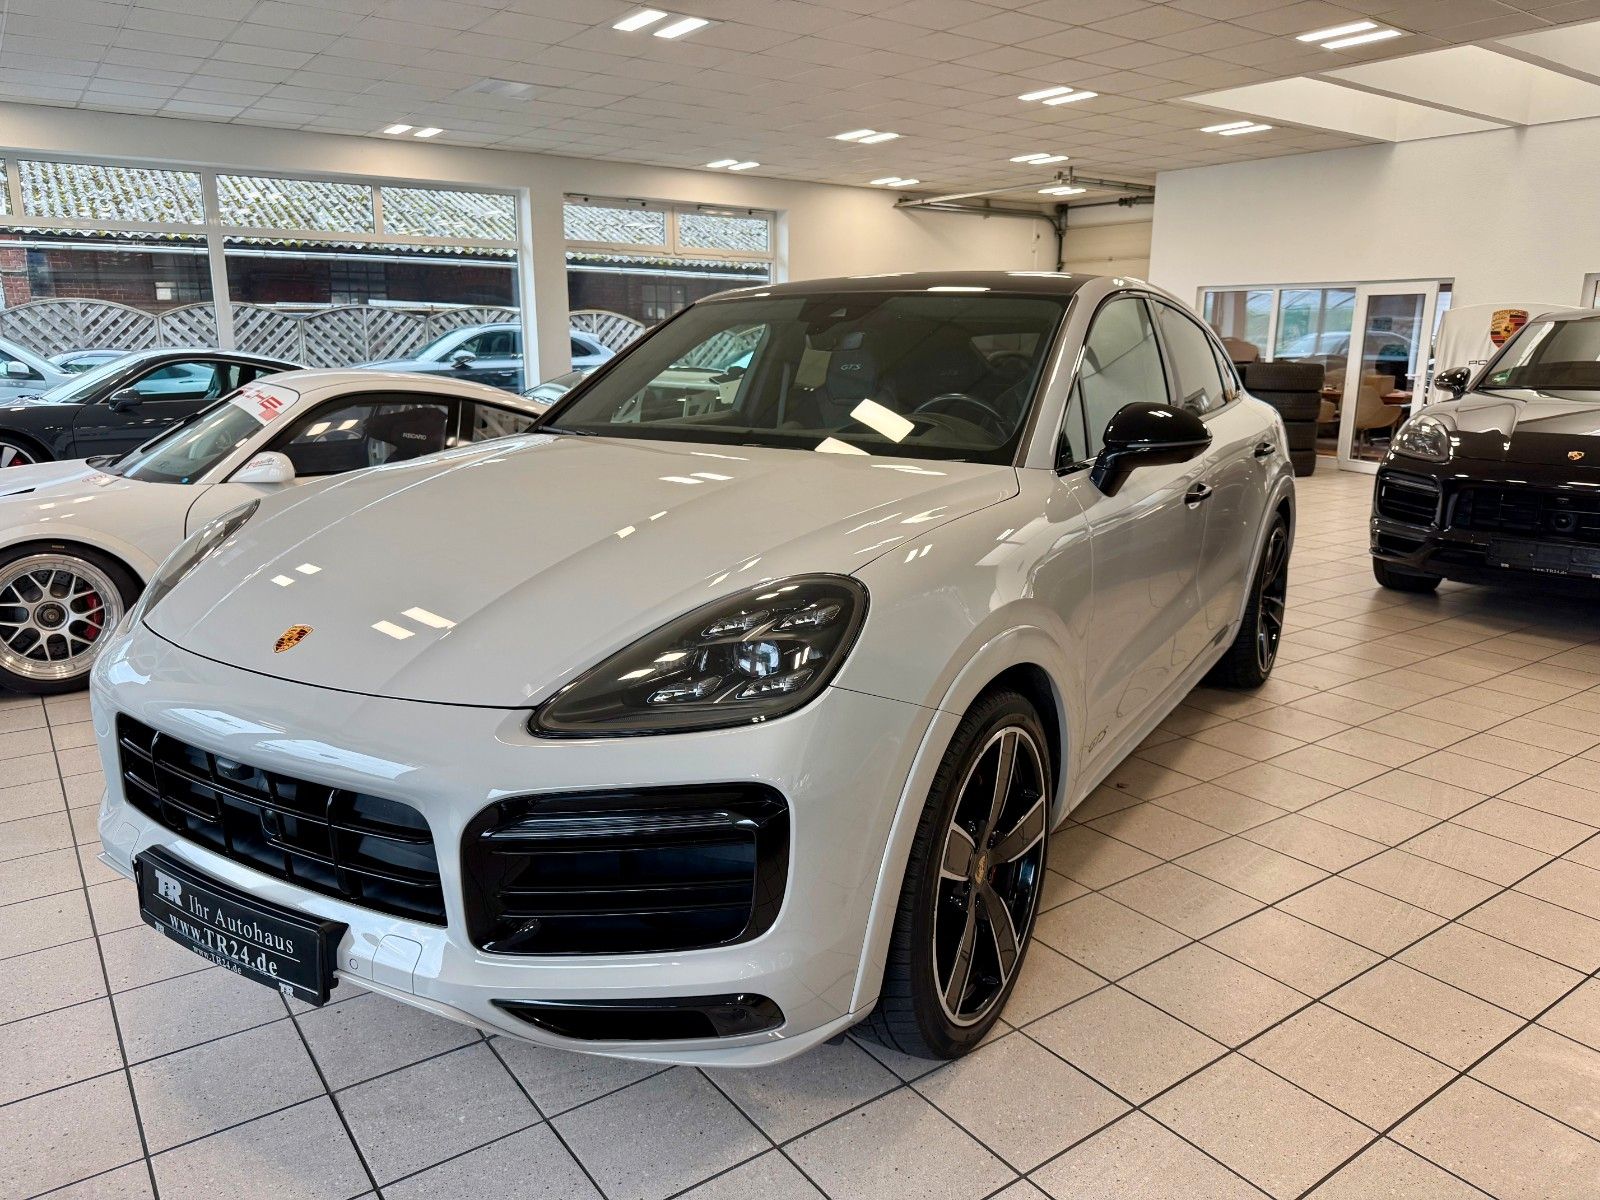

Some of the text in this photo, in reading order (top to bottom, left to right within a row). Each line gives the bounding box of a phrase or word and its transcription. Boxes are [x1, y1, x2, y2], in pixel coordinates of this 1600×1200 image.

[169, 914, 278, 976] www.TR24.de
[189, 894, 294, 953] Ihr Autohaus
[192, 945, 243, 975] www.TR24.de
